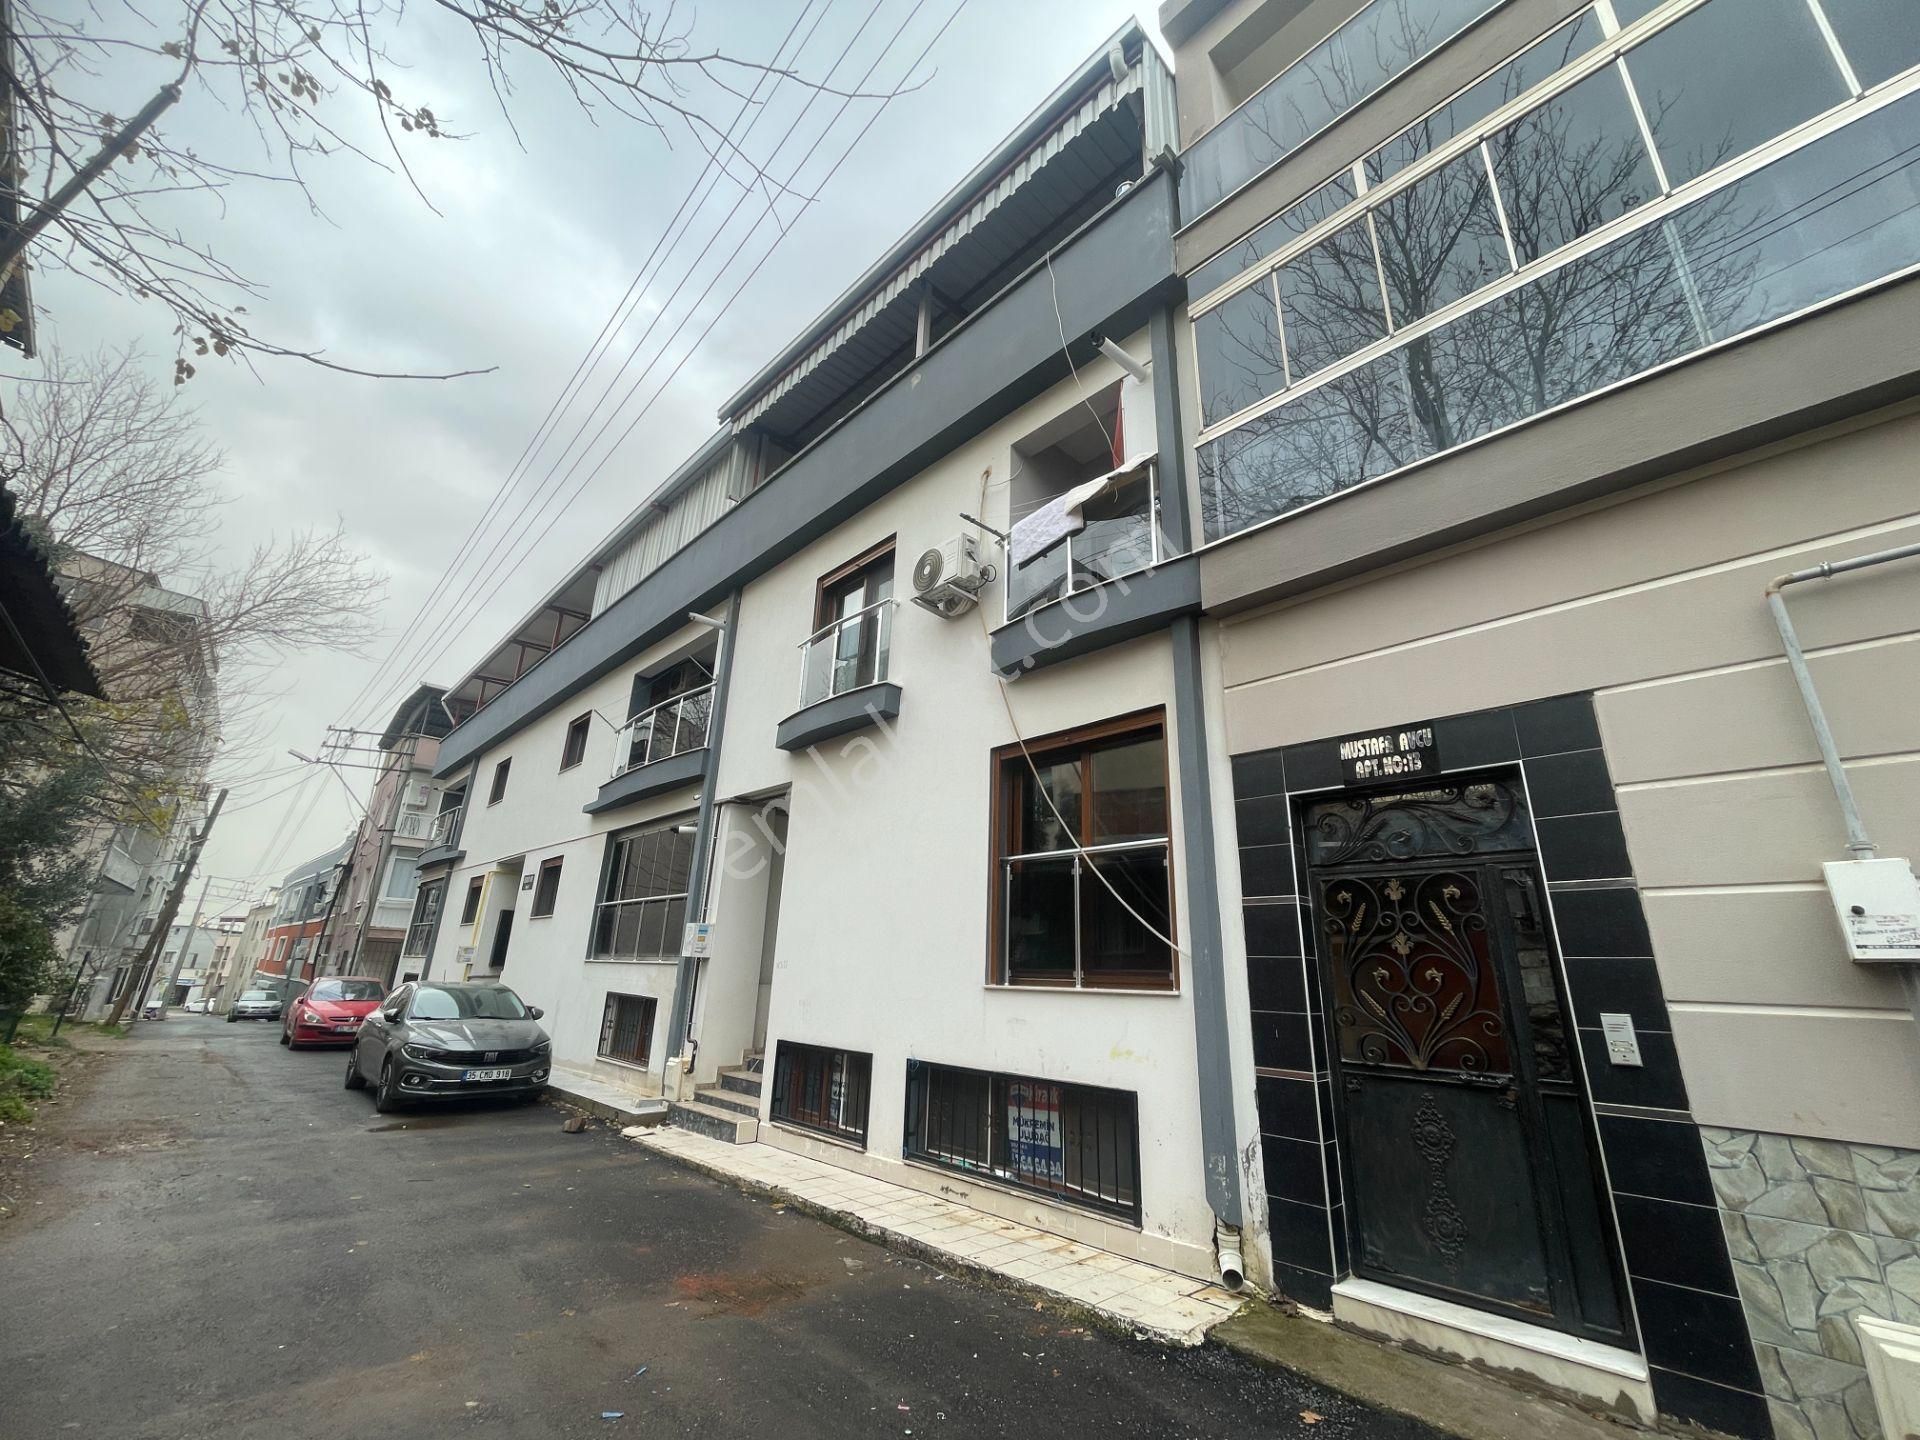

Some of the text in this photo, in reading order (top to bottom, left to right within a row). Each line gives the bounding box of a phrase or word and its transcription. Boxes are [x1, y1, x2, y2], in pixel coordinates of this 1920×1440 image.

[1340, 727, 1433, 761] MUSTAFA AVCU
[466, 1071, 477, 1080] 35
